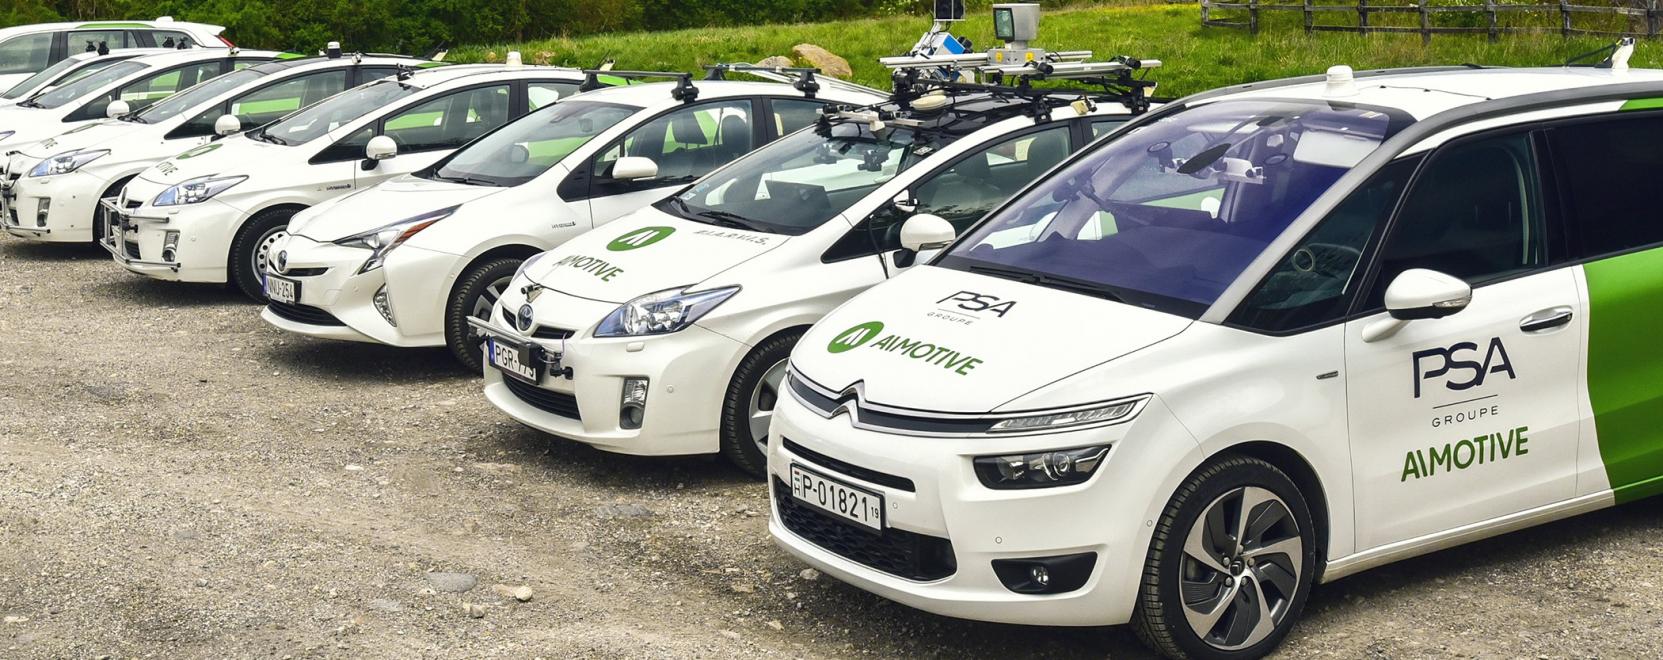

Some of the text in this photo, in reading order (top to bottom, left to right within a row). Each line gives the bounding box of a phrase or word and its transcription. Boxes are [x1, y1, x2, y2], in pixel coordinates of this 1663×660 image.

[926, 312, 974, 326] GROUPE
[936, 290, 1017, 318] PSA
[869, 334, 984, 376] AIMOTIVE
[1412, 336, 1516, 398] PSA
[1431, 405, 1499, 428] GROUPE
[1400, 425, 1529, 482] AIMOTIVE
[794, 482, 801, 496] H
[803, 474, 879, 522] P-01821 19
